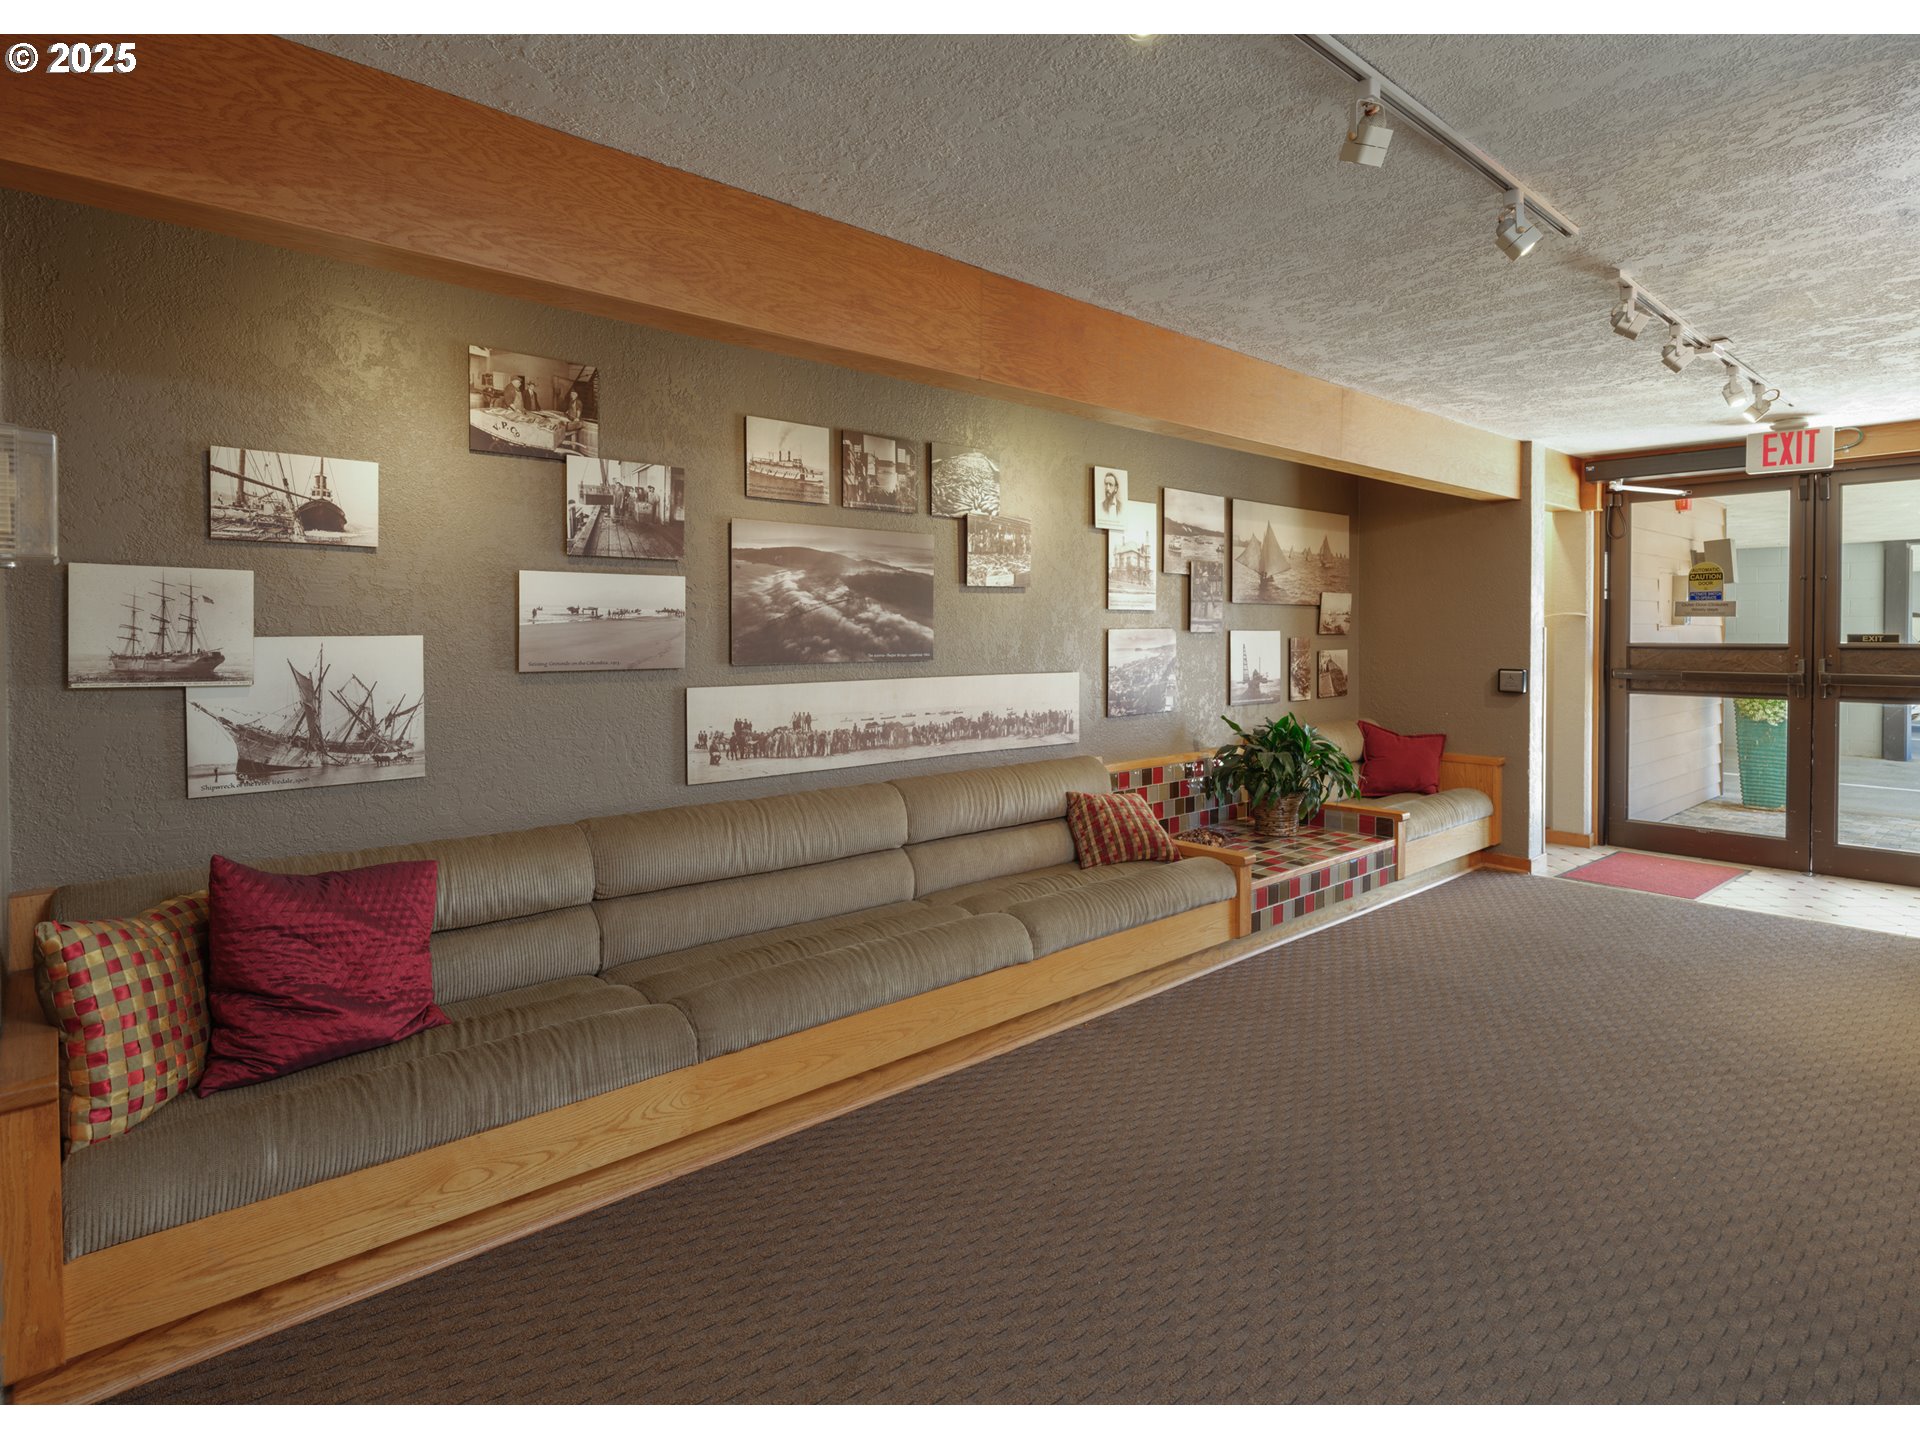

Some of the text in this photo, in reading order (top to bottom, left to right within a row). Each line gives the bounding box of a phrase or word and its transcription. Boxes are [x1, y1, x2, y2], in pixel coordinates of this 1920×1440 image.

[1762, 428, 1820, 467] EXIT
[1690, 573, 1722, 581] CAUTION
[200, 782, 236, 793] Shipwreck
